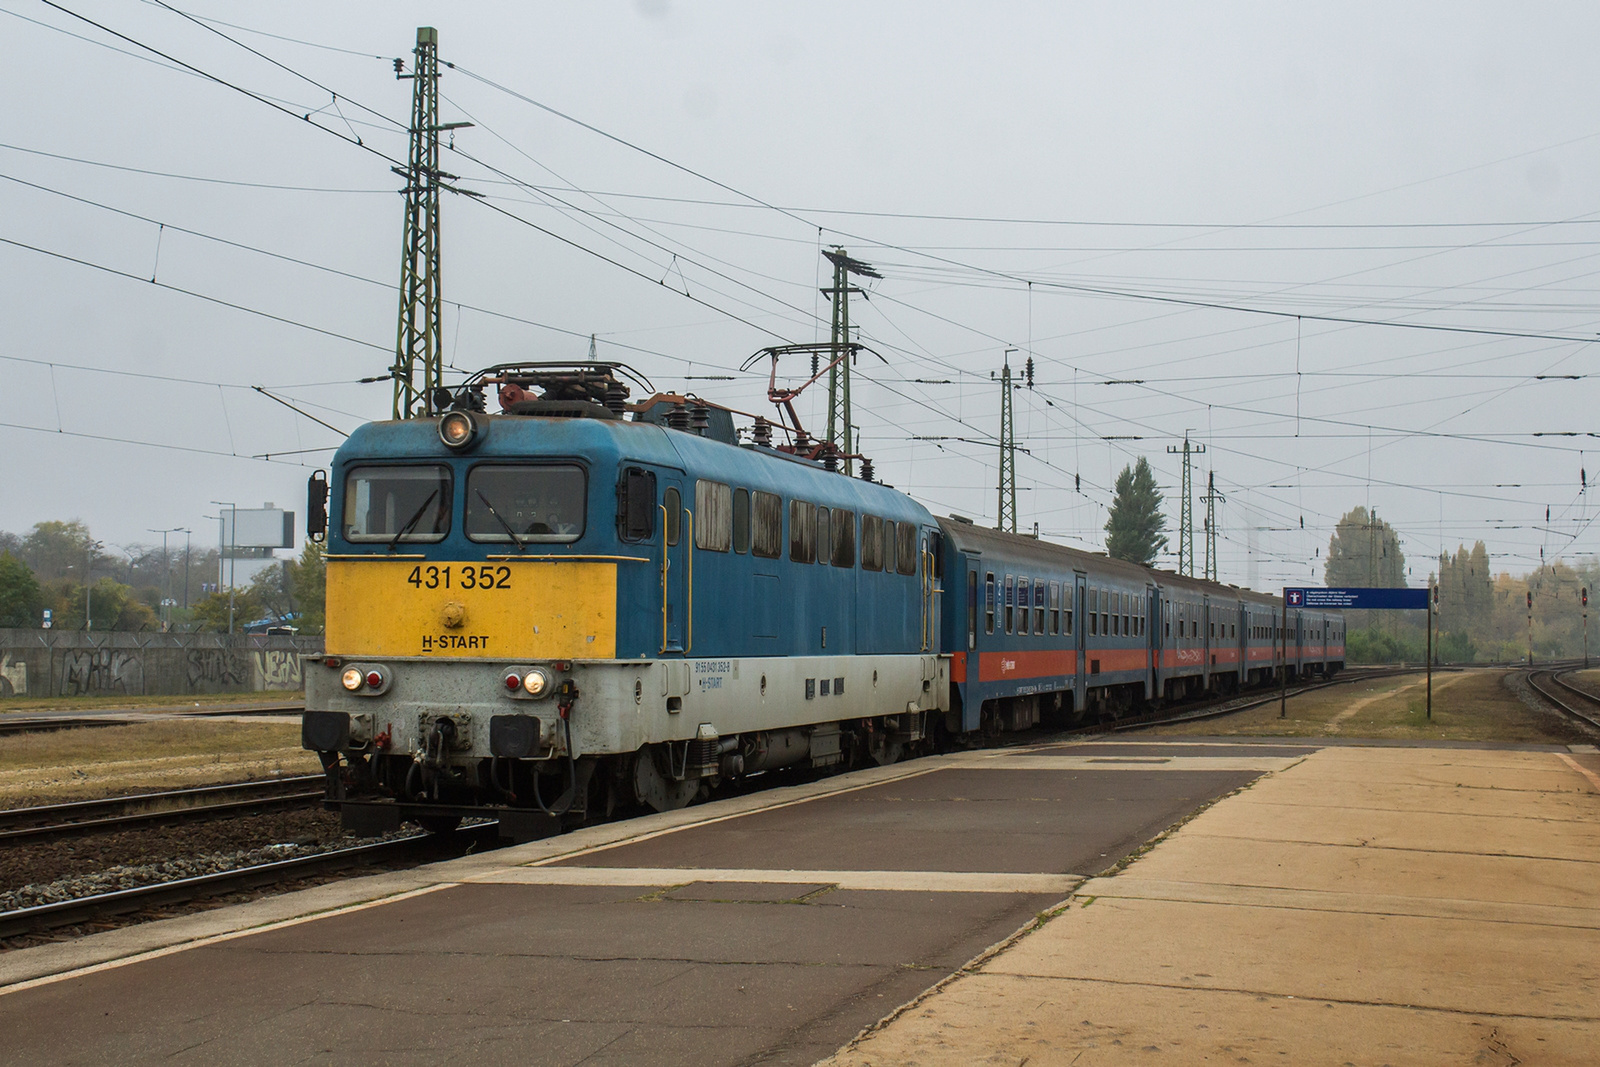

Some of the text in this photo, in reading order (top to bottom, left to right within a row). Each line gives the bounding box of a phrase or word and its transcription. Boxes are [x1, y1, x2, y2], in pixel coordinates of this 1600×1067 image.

[407, 565, 512, 590] 431 352
[422, 635, 490, 653] H-START
[702, 677, 722, 692] H-START
